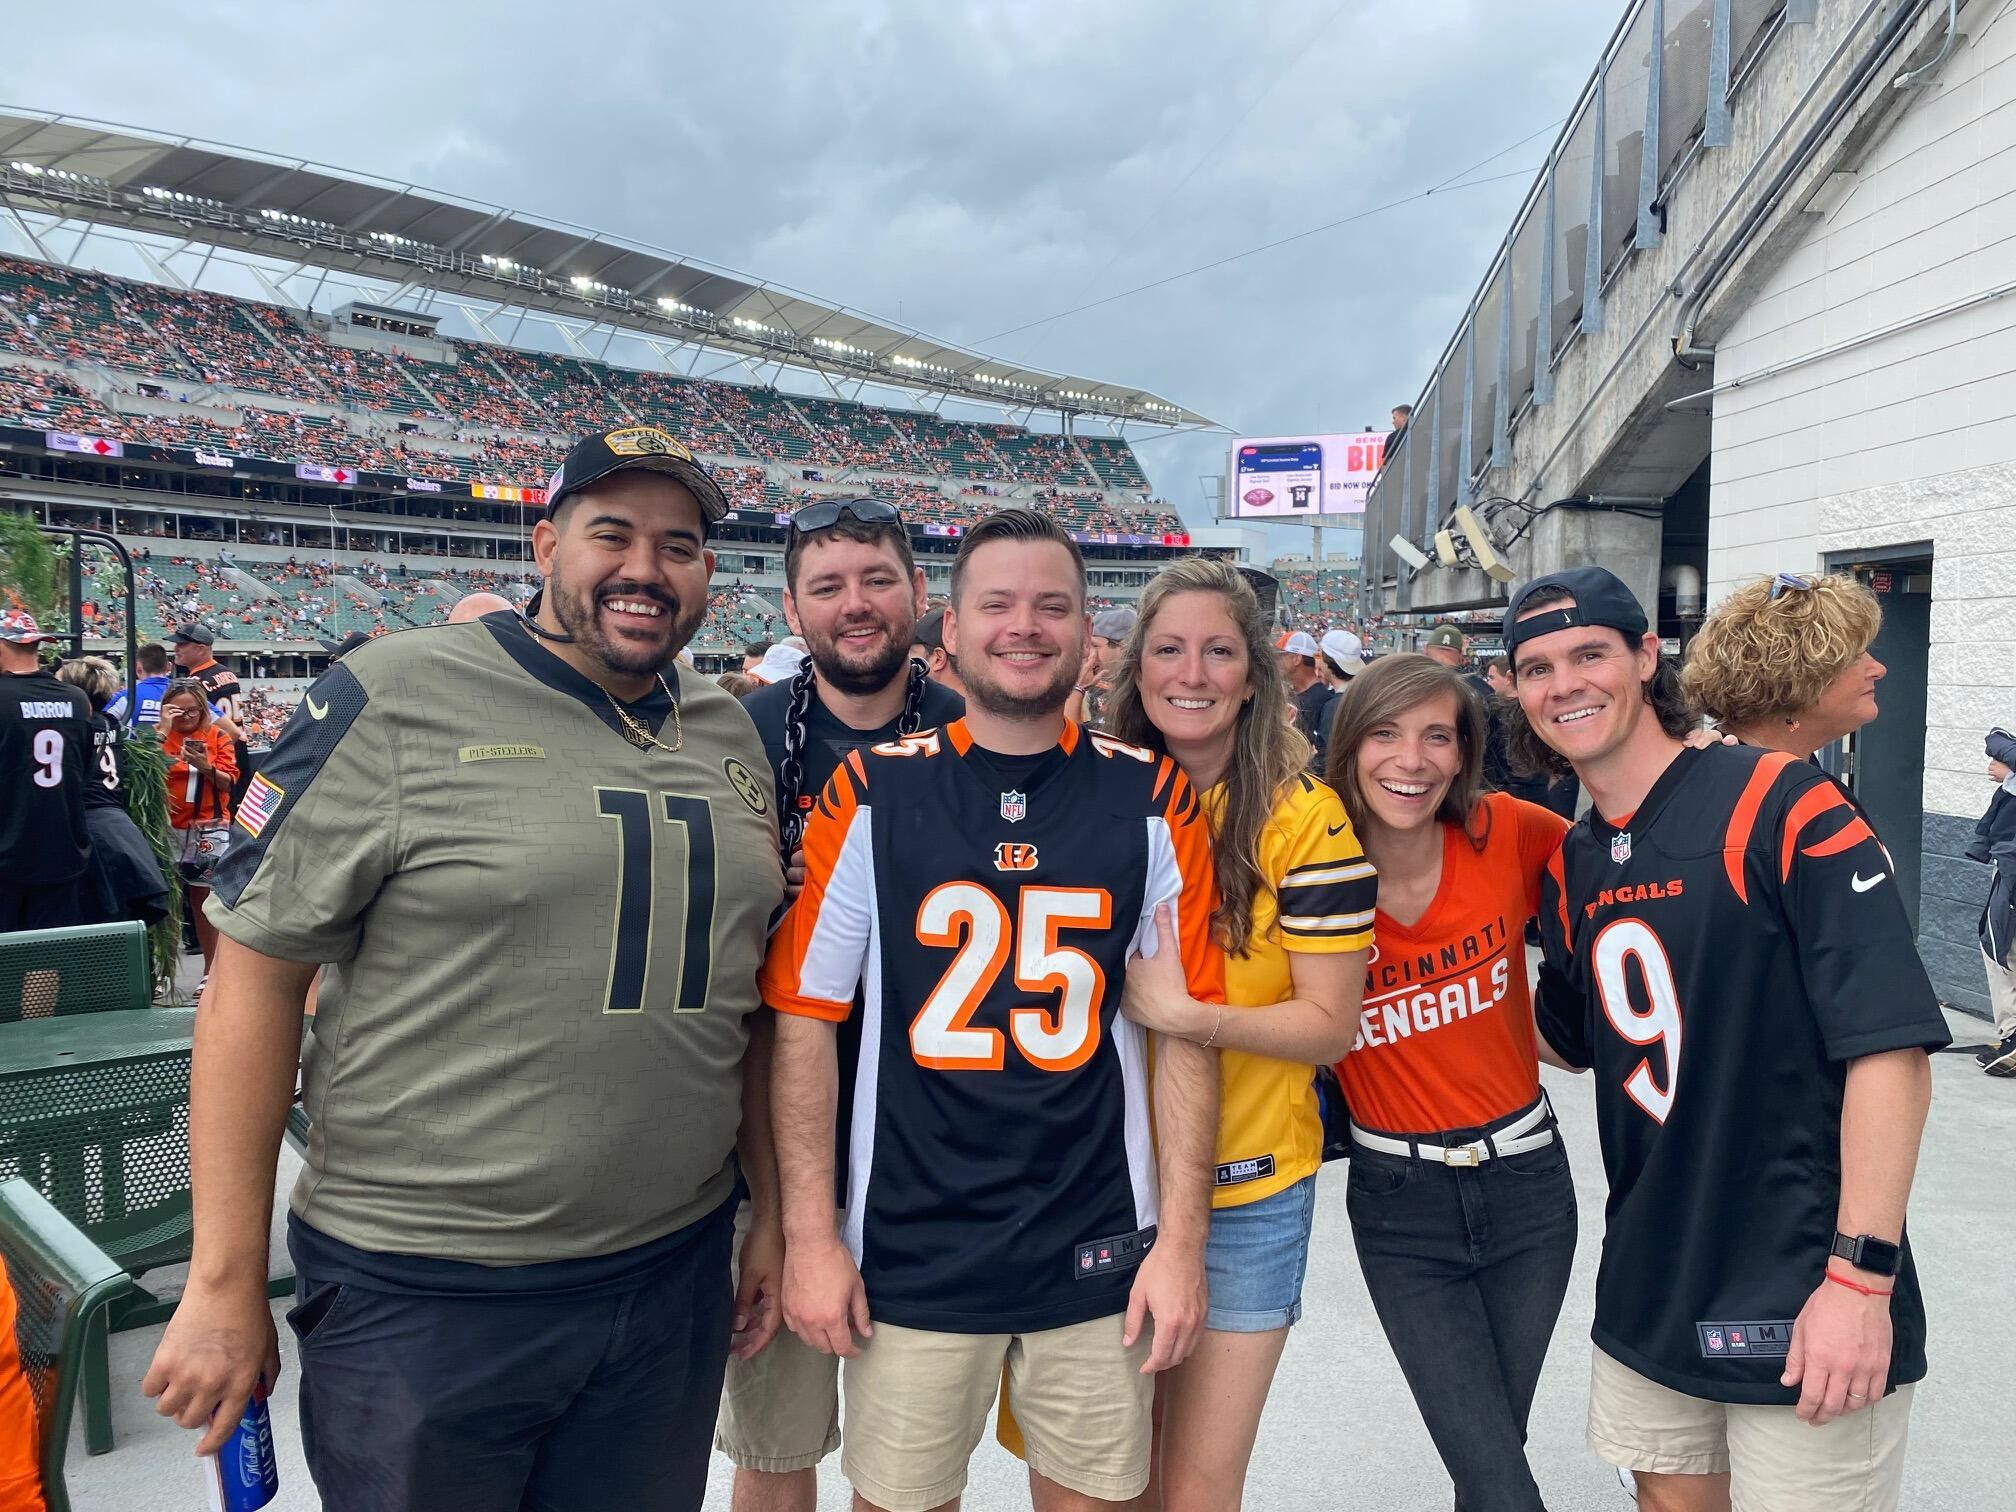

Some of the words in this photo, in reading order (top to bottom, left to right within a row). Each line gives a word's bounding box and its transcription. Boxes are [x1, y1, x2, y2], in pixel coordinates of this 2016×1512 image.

[195, 451, 234, 468] Steelers
[406, 477, 441, 492] Steelers
[20, 701, 73, 719] BURROW
[33, 729, 64, 788] 9
[469, 746, 537, 759] PIT-STEELERS
[593, 786, 718, 1014] 11
[1363, 916, 1507, 995] NCINNATI
[909, 880, 1112, 1072] 25
[1592, 917, 1683, 1126] 9
[1232, 1162, 1257, 1170] TEAM
[1122, 1239, 1133, 1252] M
[1759, 1327, 1776, 1340] M
[258, 1406, 276, 1485] ULTRA
